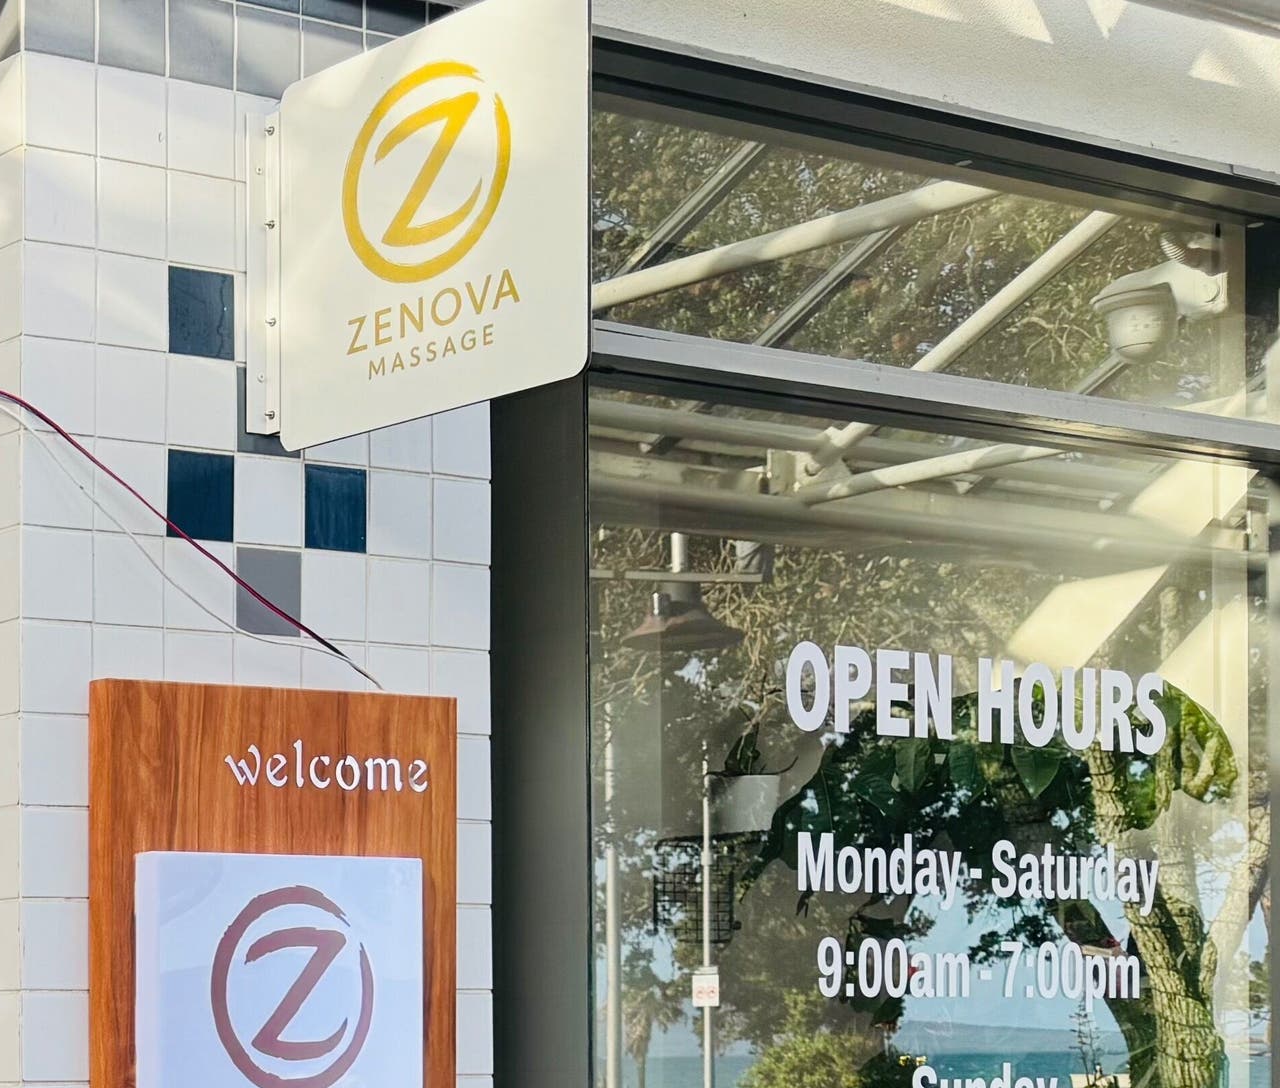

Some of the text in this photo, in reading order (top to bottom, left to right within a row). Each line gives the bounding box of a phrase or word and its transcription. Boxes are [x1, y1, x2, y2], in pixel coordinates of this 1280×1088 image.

[346, 268, 521, 356] ZENOVA
[367, 323, 495, 380] MASSAGE
[785, 640, 1167, 756] OPEN HOURS
[224, 739, 429, 793] welcome
[797, 831, 962, 911] Monday
[991, 839, 1159, 916] Saturday
[817, 936, 971, 999] 9:00am
[1000, 941, 1141, 1011] 7:00pm
